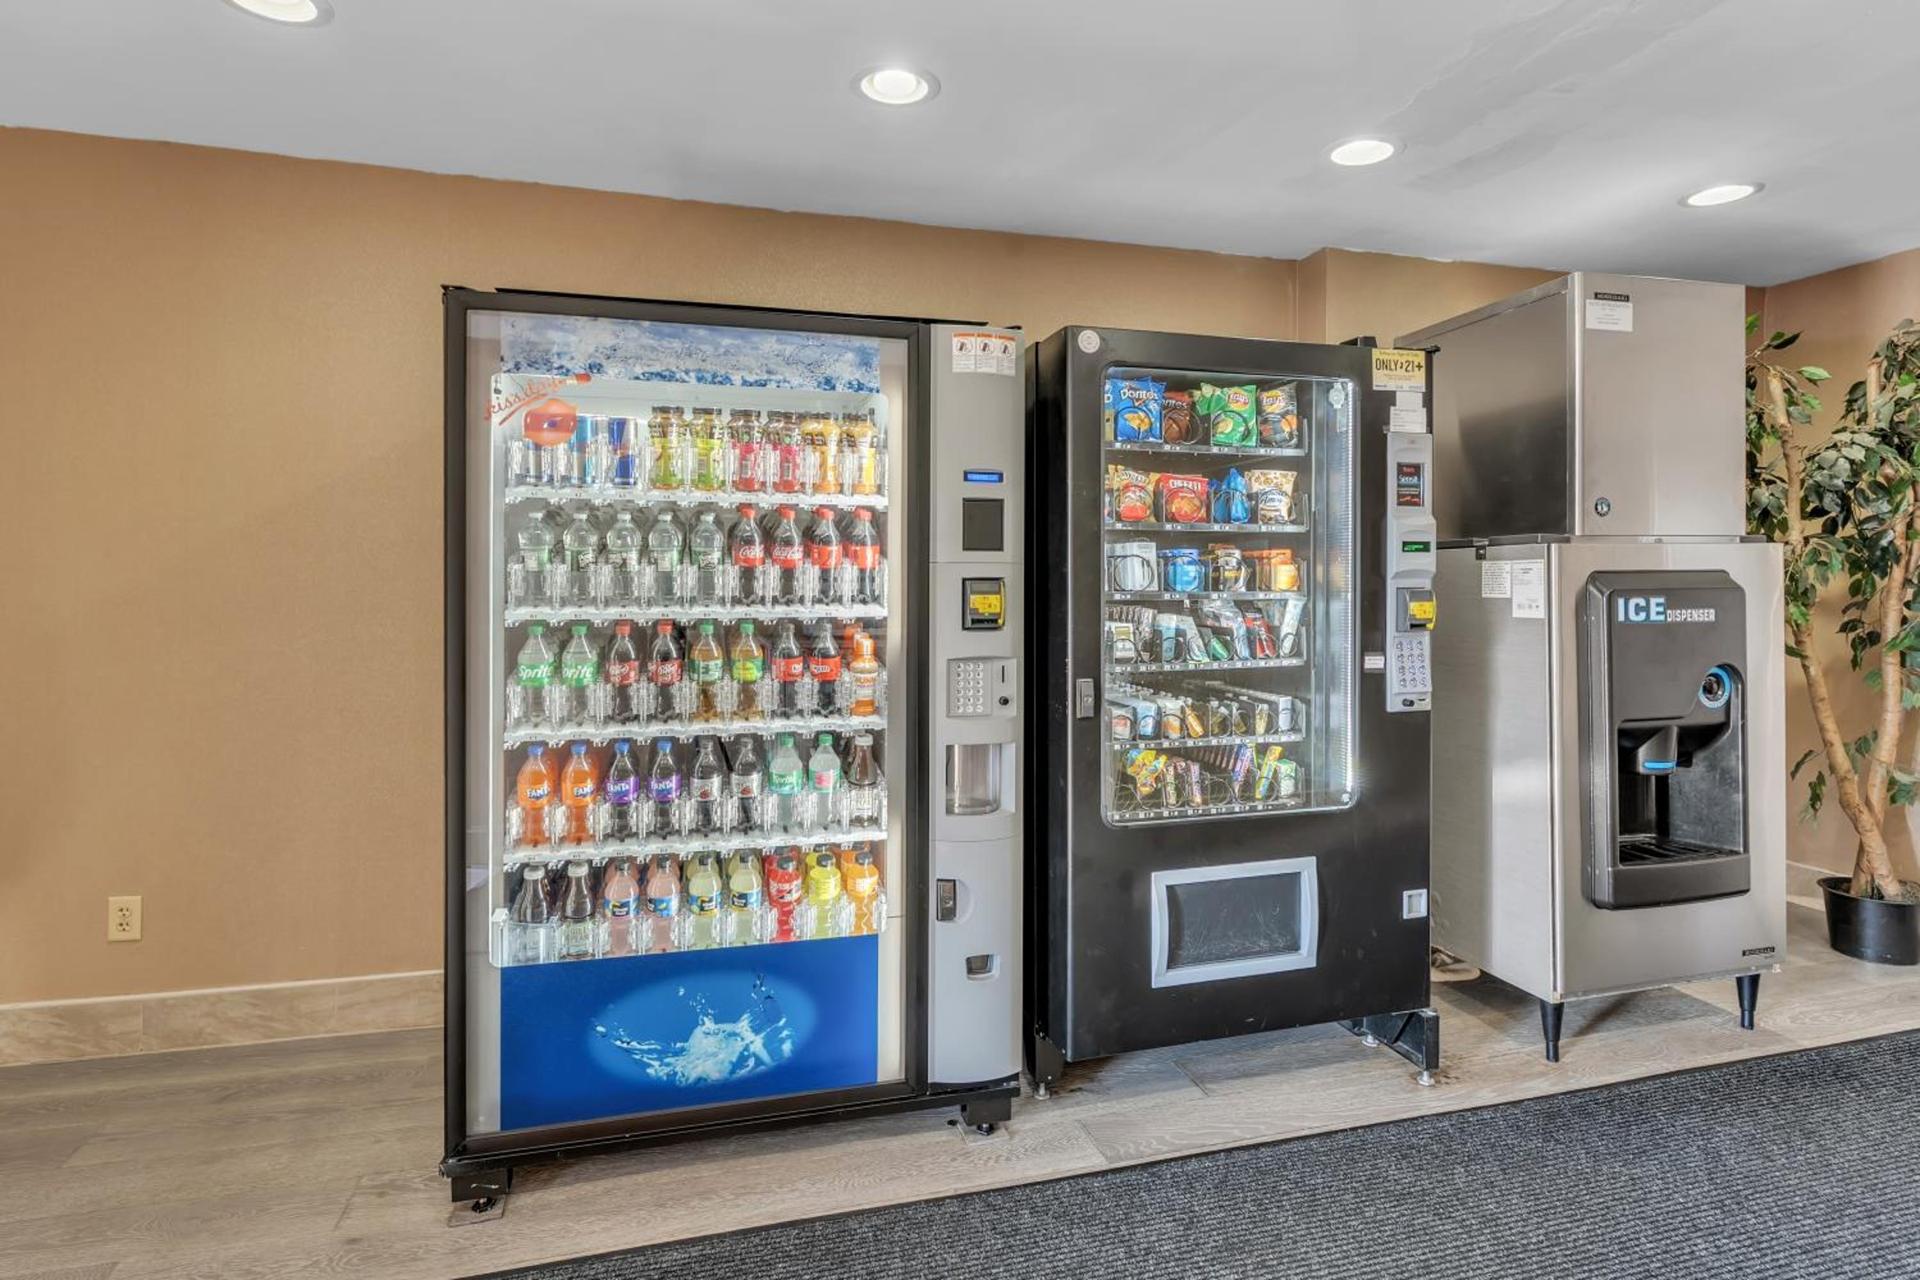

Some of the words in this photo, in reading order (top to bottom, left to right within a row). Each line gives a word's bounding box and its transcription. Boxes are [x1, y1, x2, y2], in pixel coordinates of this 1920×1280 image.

[1375, 358, 1398, 371] ONLY
[1404, 360, 1424, 372] 21+
[1120, 388, 1159, 401] Doritos
[1617, 597, 1665, 622] ICE
[1666, 609, 1716, 622] DISPENSER
[519, 664, 554, 681] Sprite
[562, 664, 594, 680] prite
